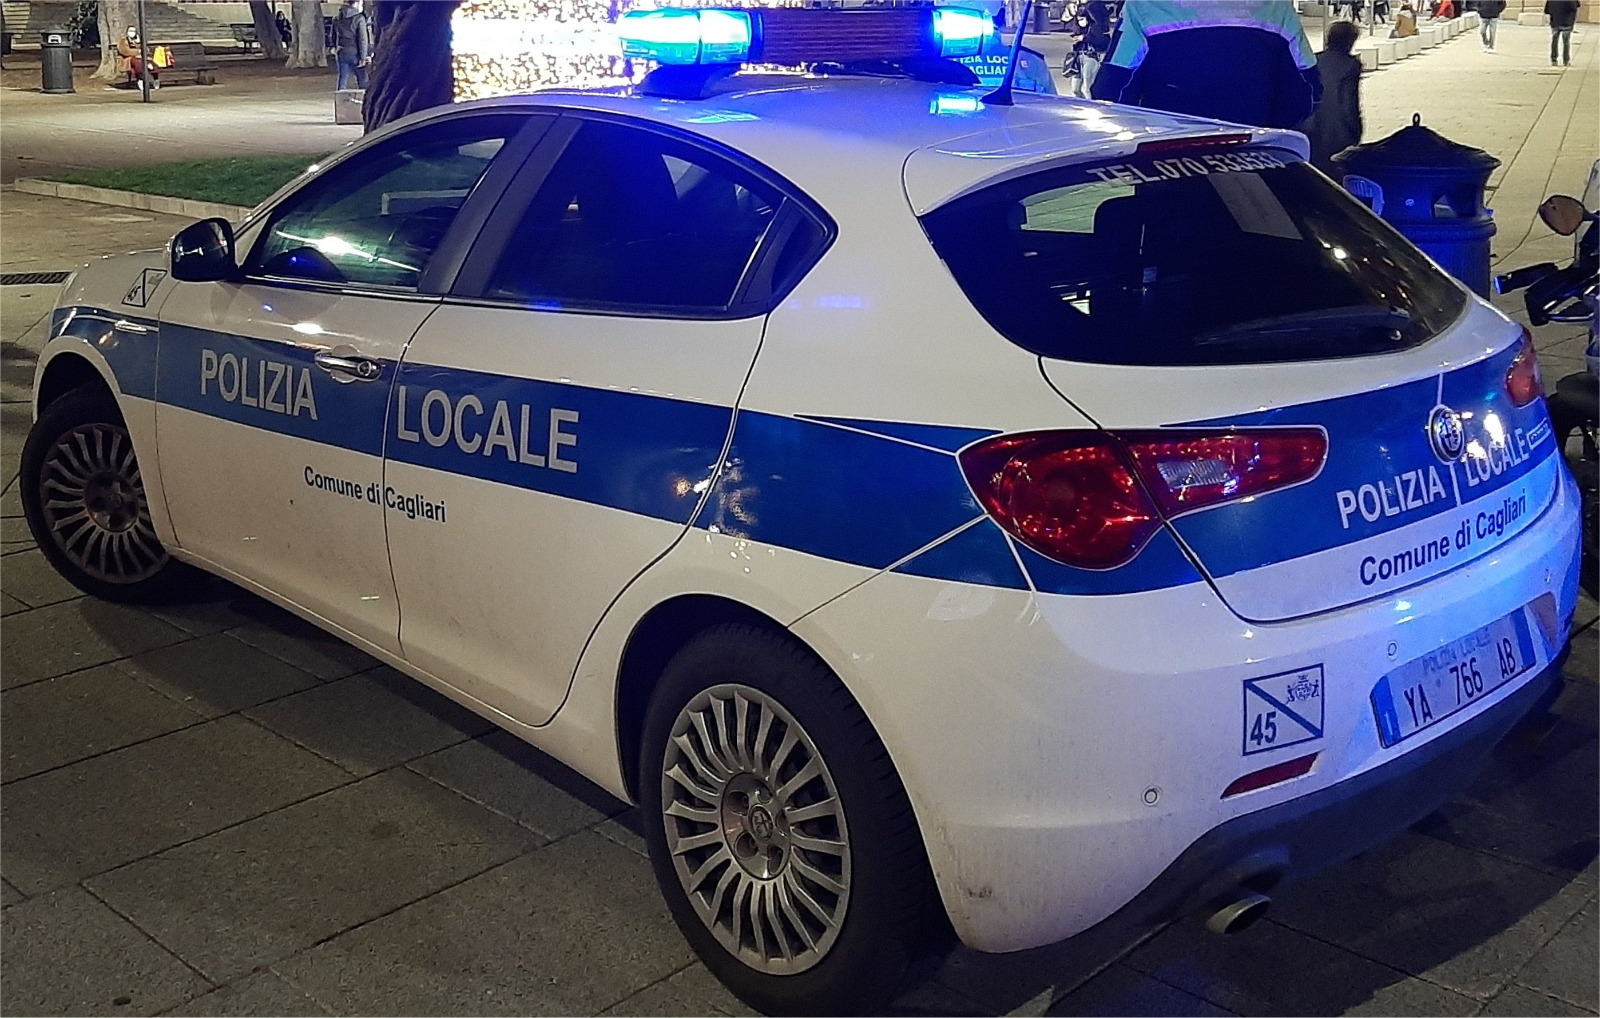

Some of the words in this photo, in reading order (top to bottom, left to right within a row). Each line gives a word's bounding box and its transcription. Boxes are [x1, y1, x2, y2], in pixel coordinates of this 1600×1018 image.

[200, 348, 318, 421] POLIZIA
[397, 385, 580, 474] LOCALE
[303, 465, 363, 501] Comune
[366, 482, 381, 505] di
[385, 486, 446, 522] Cagliari
[1336, 465, 1447, 529] POLIZIA
[1464, 427, 1530, 487] LOCALE
[1359, 536, 1451, 586] Comune
[1455, 520, 1471, 551] di
[1475, 488, 1527, 537] Cagliari
[1250, 711, 1277, 746] 45
[1403, 683, 1433, 727] YA
[1449, 657, 1483, 705] 766
[1497, 637, 1516, 680] AB
